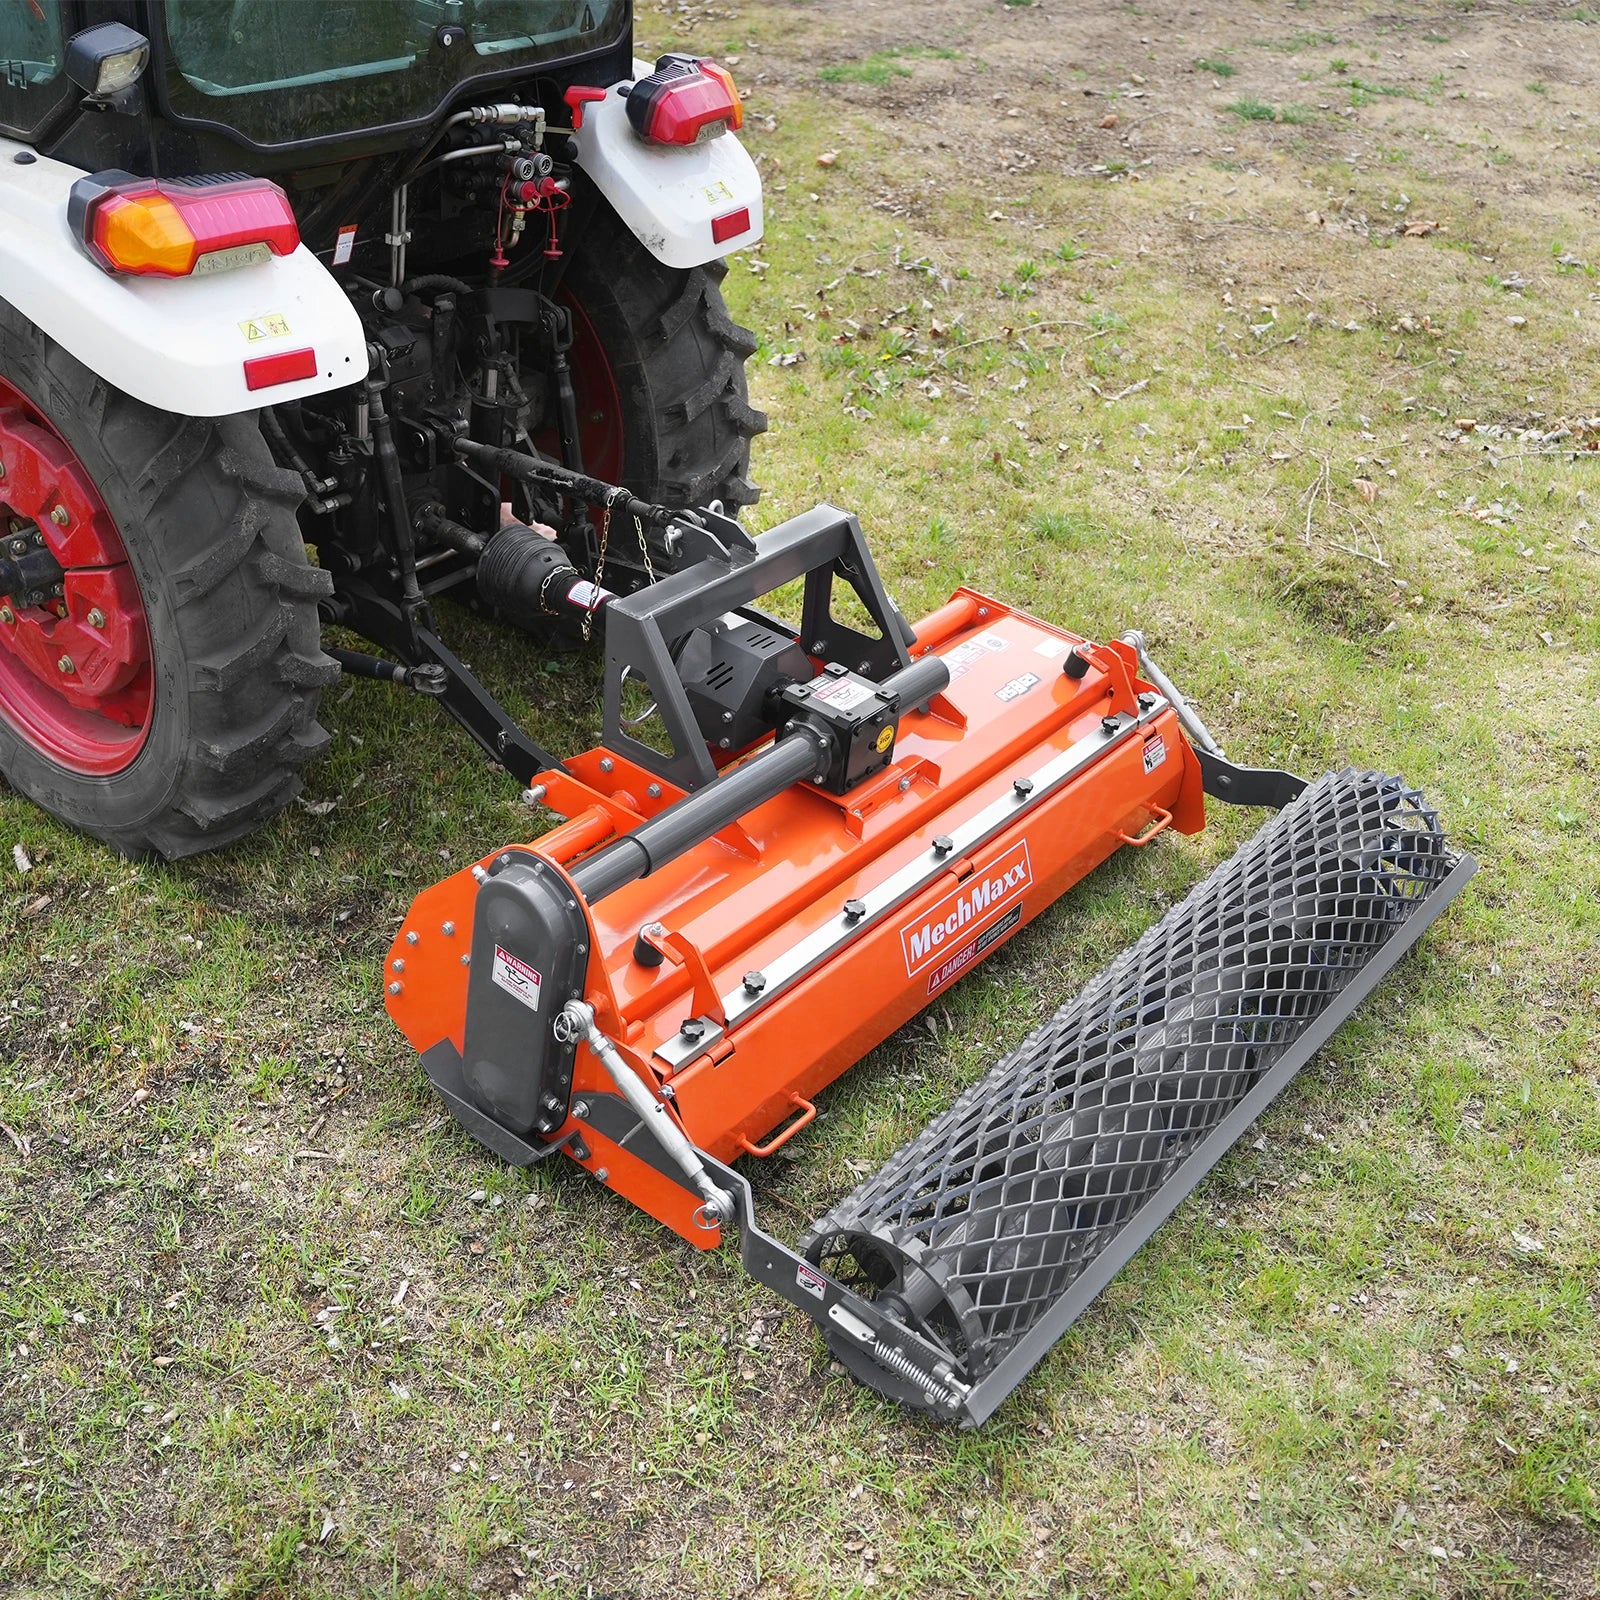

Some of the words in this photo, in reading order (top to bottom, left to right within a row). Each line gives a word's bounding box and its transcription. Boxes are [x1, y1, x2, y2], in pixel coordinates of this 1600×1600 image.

[910, 859, 1027, 963] MechMaxx
[505, 954, 537, 982] WARNING
[941, 942, 976, 979] DANGER!
